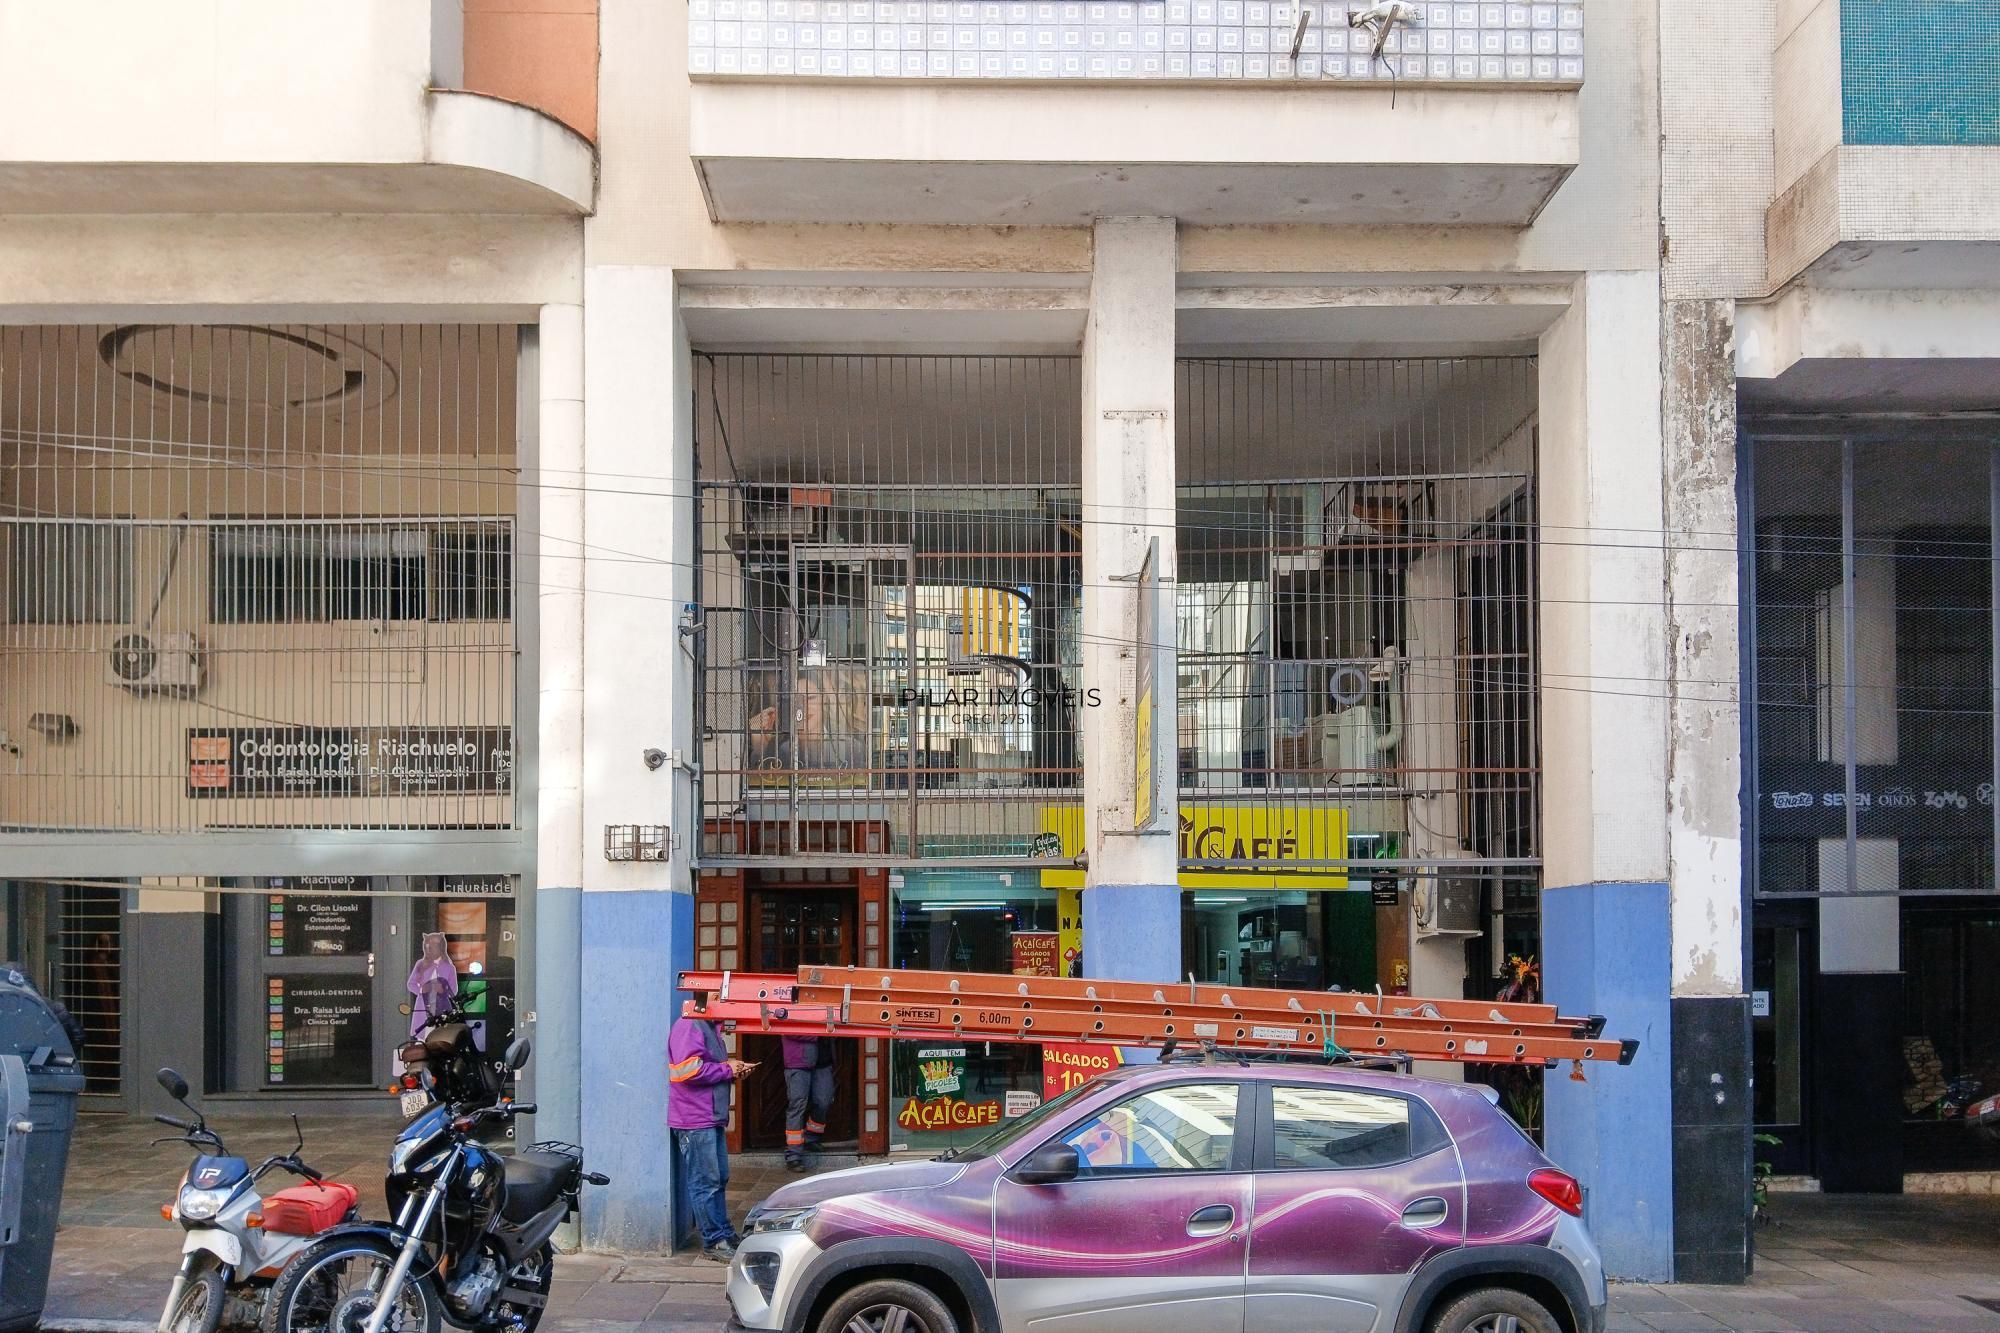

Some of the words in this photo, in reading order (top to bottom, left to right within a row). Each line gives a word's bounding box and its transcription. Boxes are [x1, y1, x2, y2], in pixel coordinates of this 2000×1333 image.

[240, 737, 370, 761] Odontologia
[378, 737, 477, 756] Riachuelo
[895, 1008, 935, 1018] SÍNTESE
[979, 1012, 1011, 1024] 6,00m
[1043, 1049, 1109, 1069] SALGADOS
[952, 1101, 998, 1124] CAFÉ
